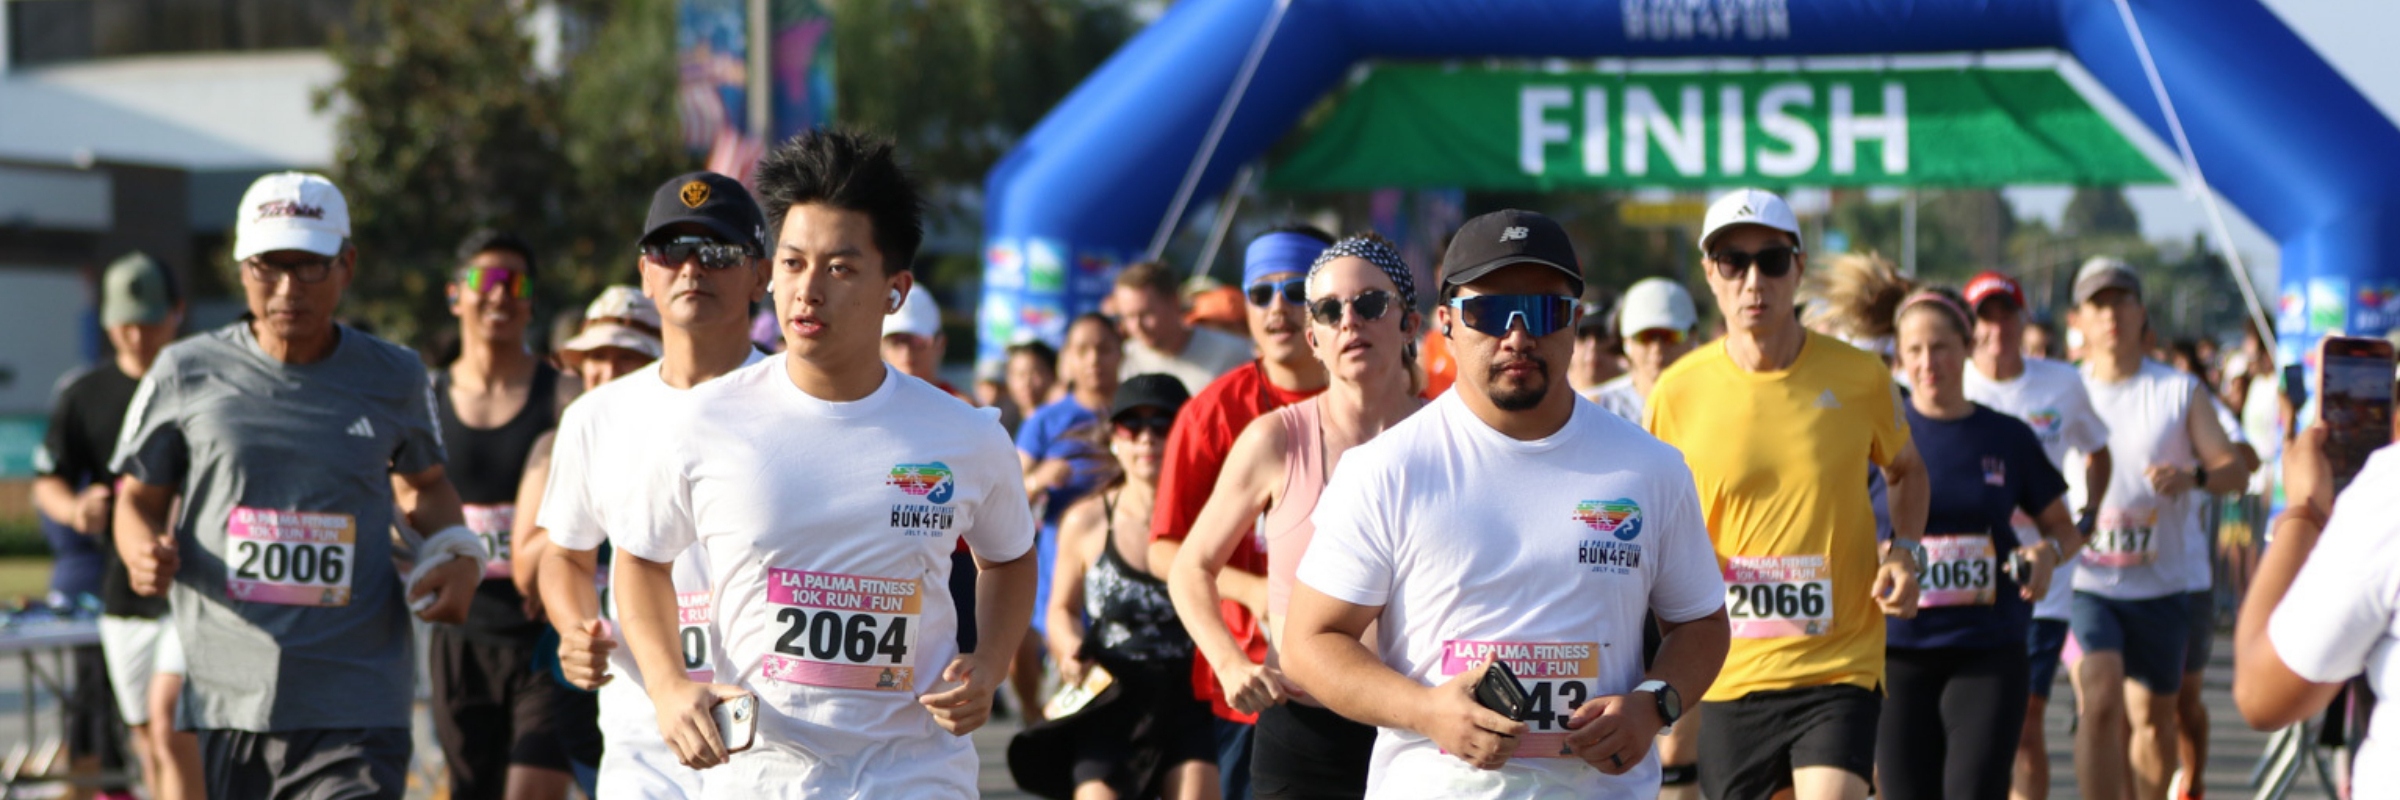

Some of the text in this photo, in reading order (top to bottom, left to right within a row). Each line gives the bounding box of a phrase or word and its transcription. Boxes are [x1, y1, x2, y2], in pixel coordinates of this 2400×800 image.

[1519, 83, 1909, 177] FINISH
[891, 511, 954, 529] RUN4FUN
[236, 541, 345, 584] 2006
[1579, 547, 1640, 568] RUN4FUN
[781, 572, 915, 596] LA PALMA FITNESS
[792, 589, 821, 605] 10K
[1729, 582, 1824, 618] 2066
[774, 607, 907, 664] 2064
[1455, 644, 1475, 658] LA
[1533, 645, 1589, 660] FITNESS
[1504, 661, 1579, 676] UN4FUN
[1523, 681, 1587, 731] 43
